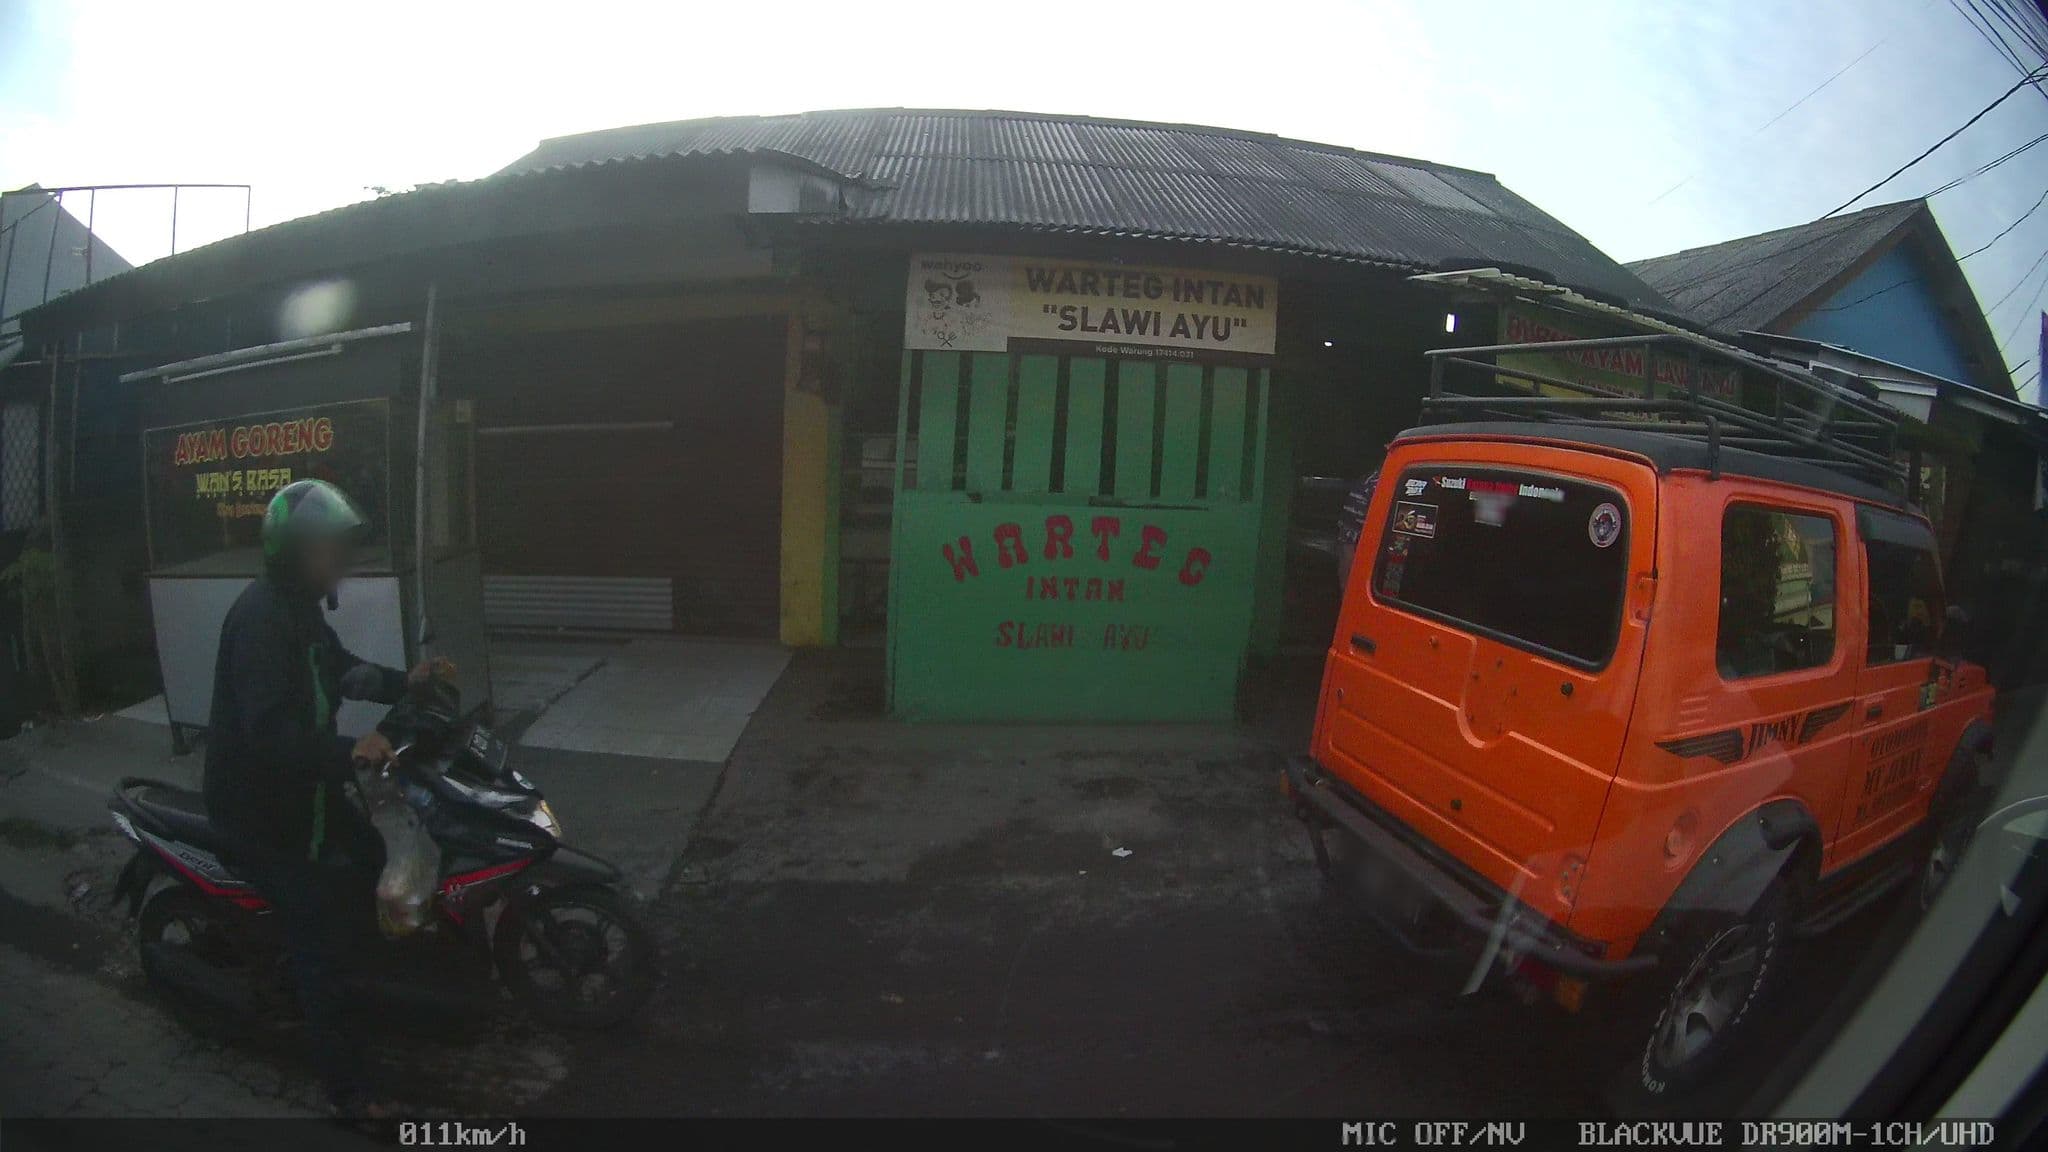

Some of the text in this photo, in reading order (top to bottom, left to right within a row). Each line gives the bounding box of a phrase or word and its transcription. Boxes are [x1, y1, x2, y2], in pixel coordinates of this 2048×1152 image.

[1025, 266, 1265, 310] WARTEG INTAN
[1043, 303, 1248, 342] "SLAWI AYU"
[1120, 346, 1153, 357] Warung
[175, 416, 335, 465] AYAM GORENG
